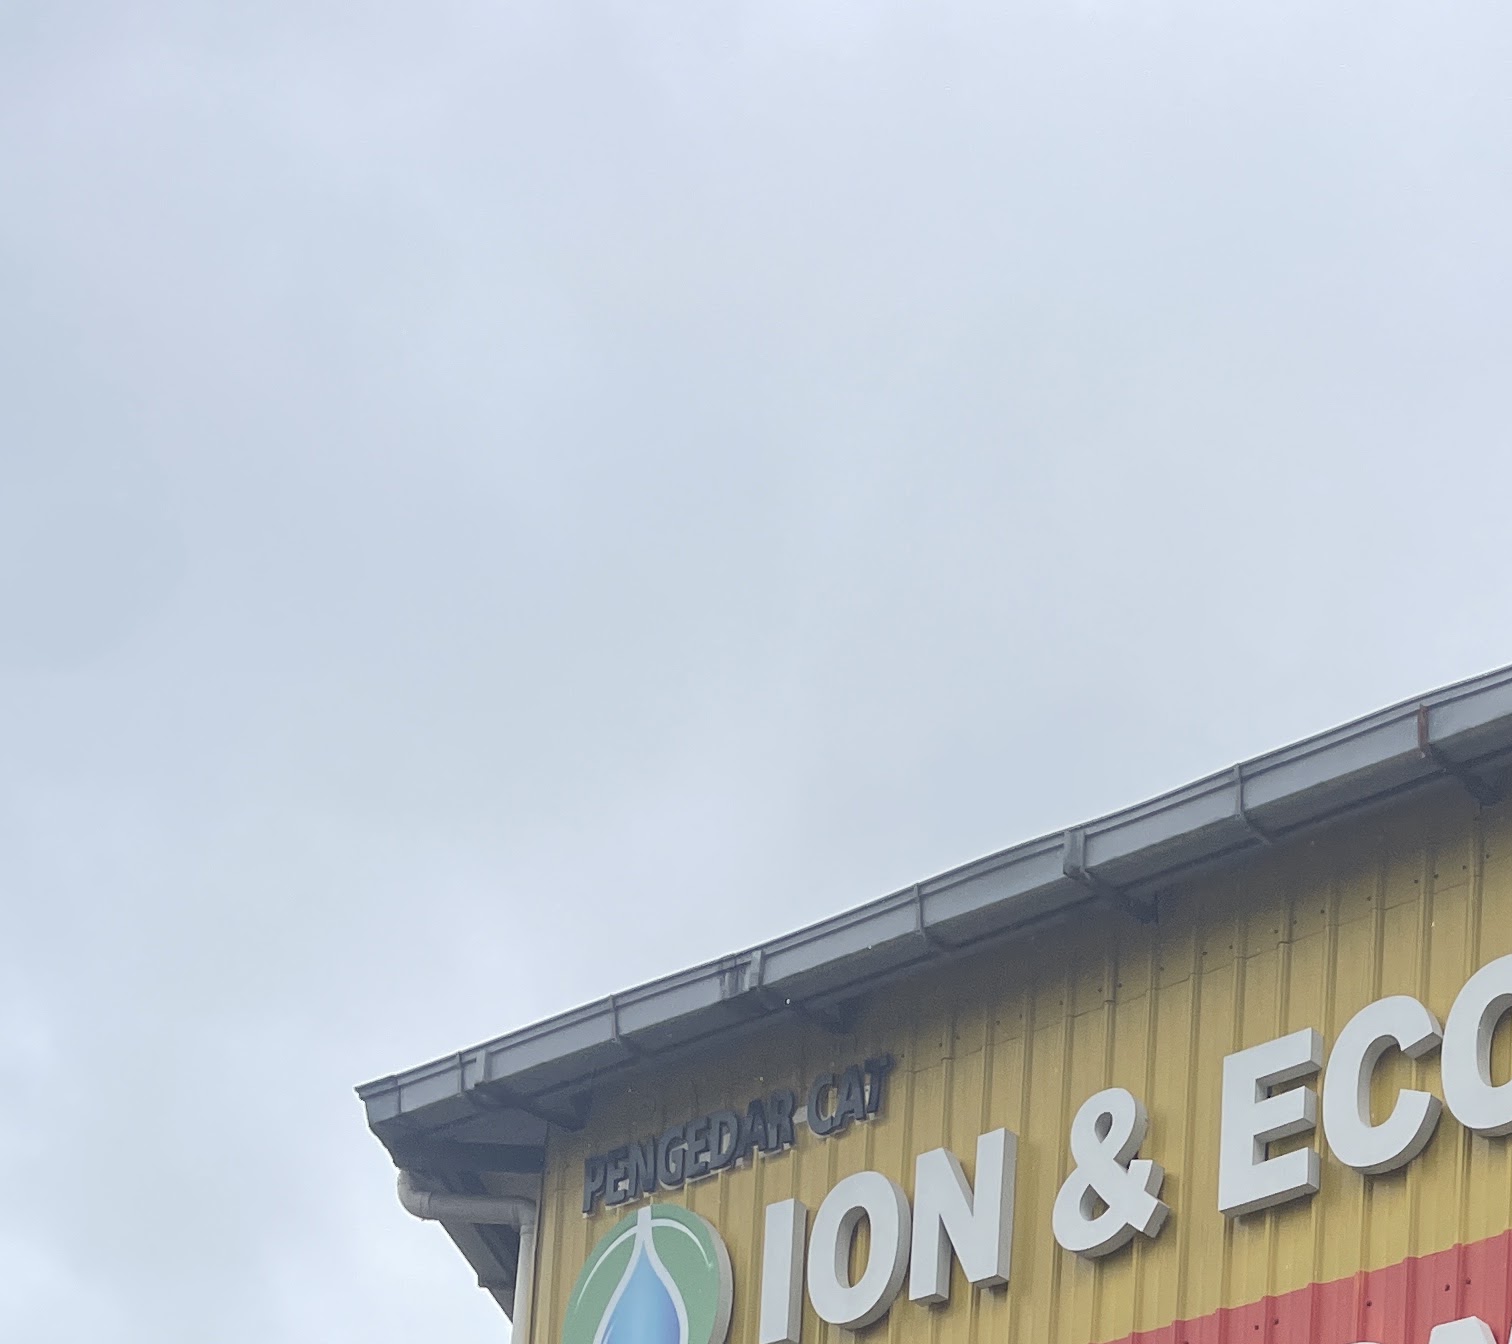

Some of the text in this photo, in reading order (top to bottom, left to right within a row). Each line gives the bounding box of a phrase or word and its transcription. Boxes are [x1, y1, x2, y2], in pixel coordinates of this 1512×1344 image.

[582, 1054, 896, 1216] PENGEDAR CAT
[1052, 1087, 1170, 1260] &
